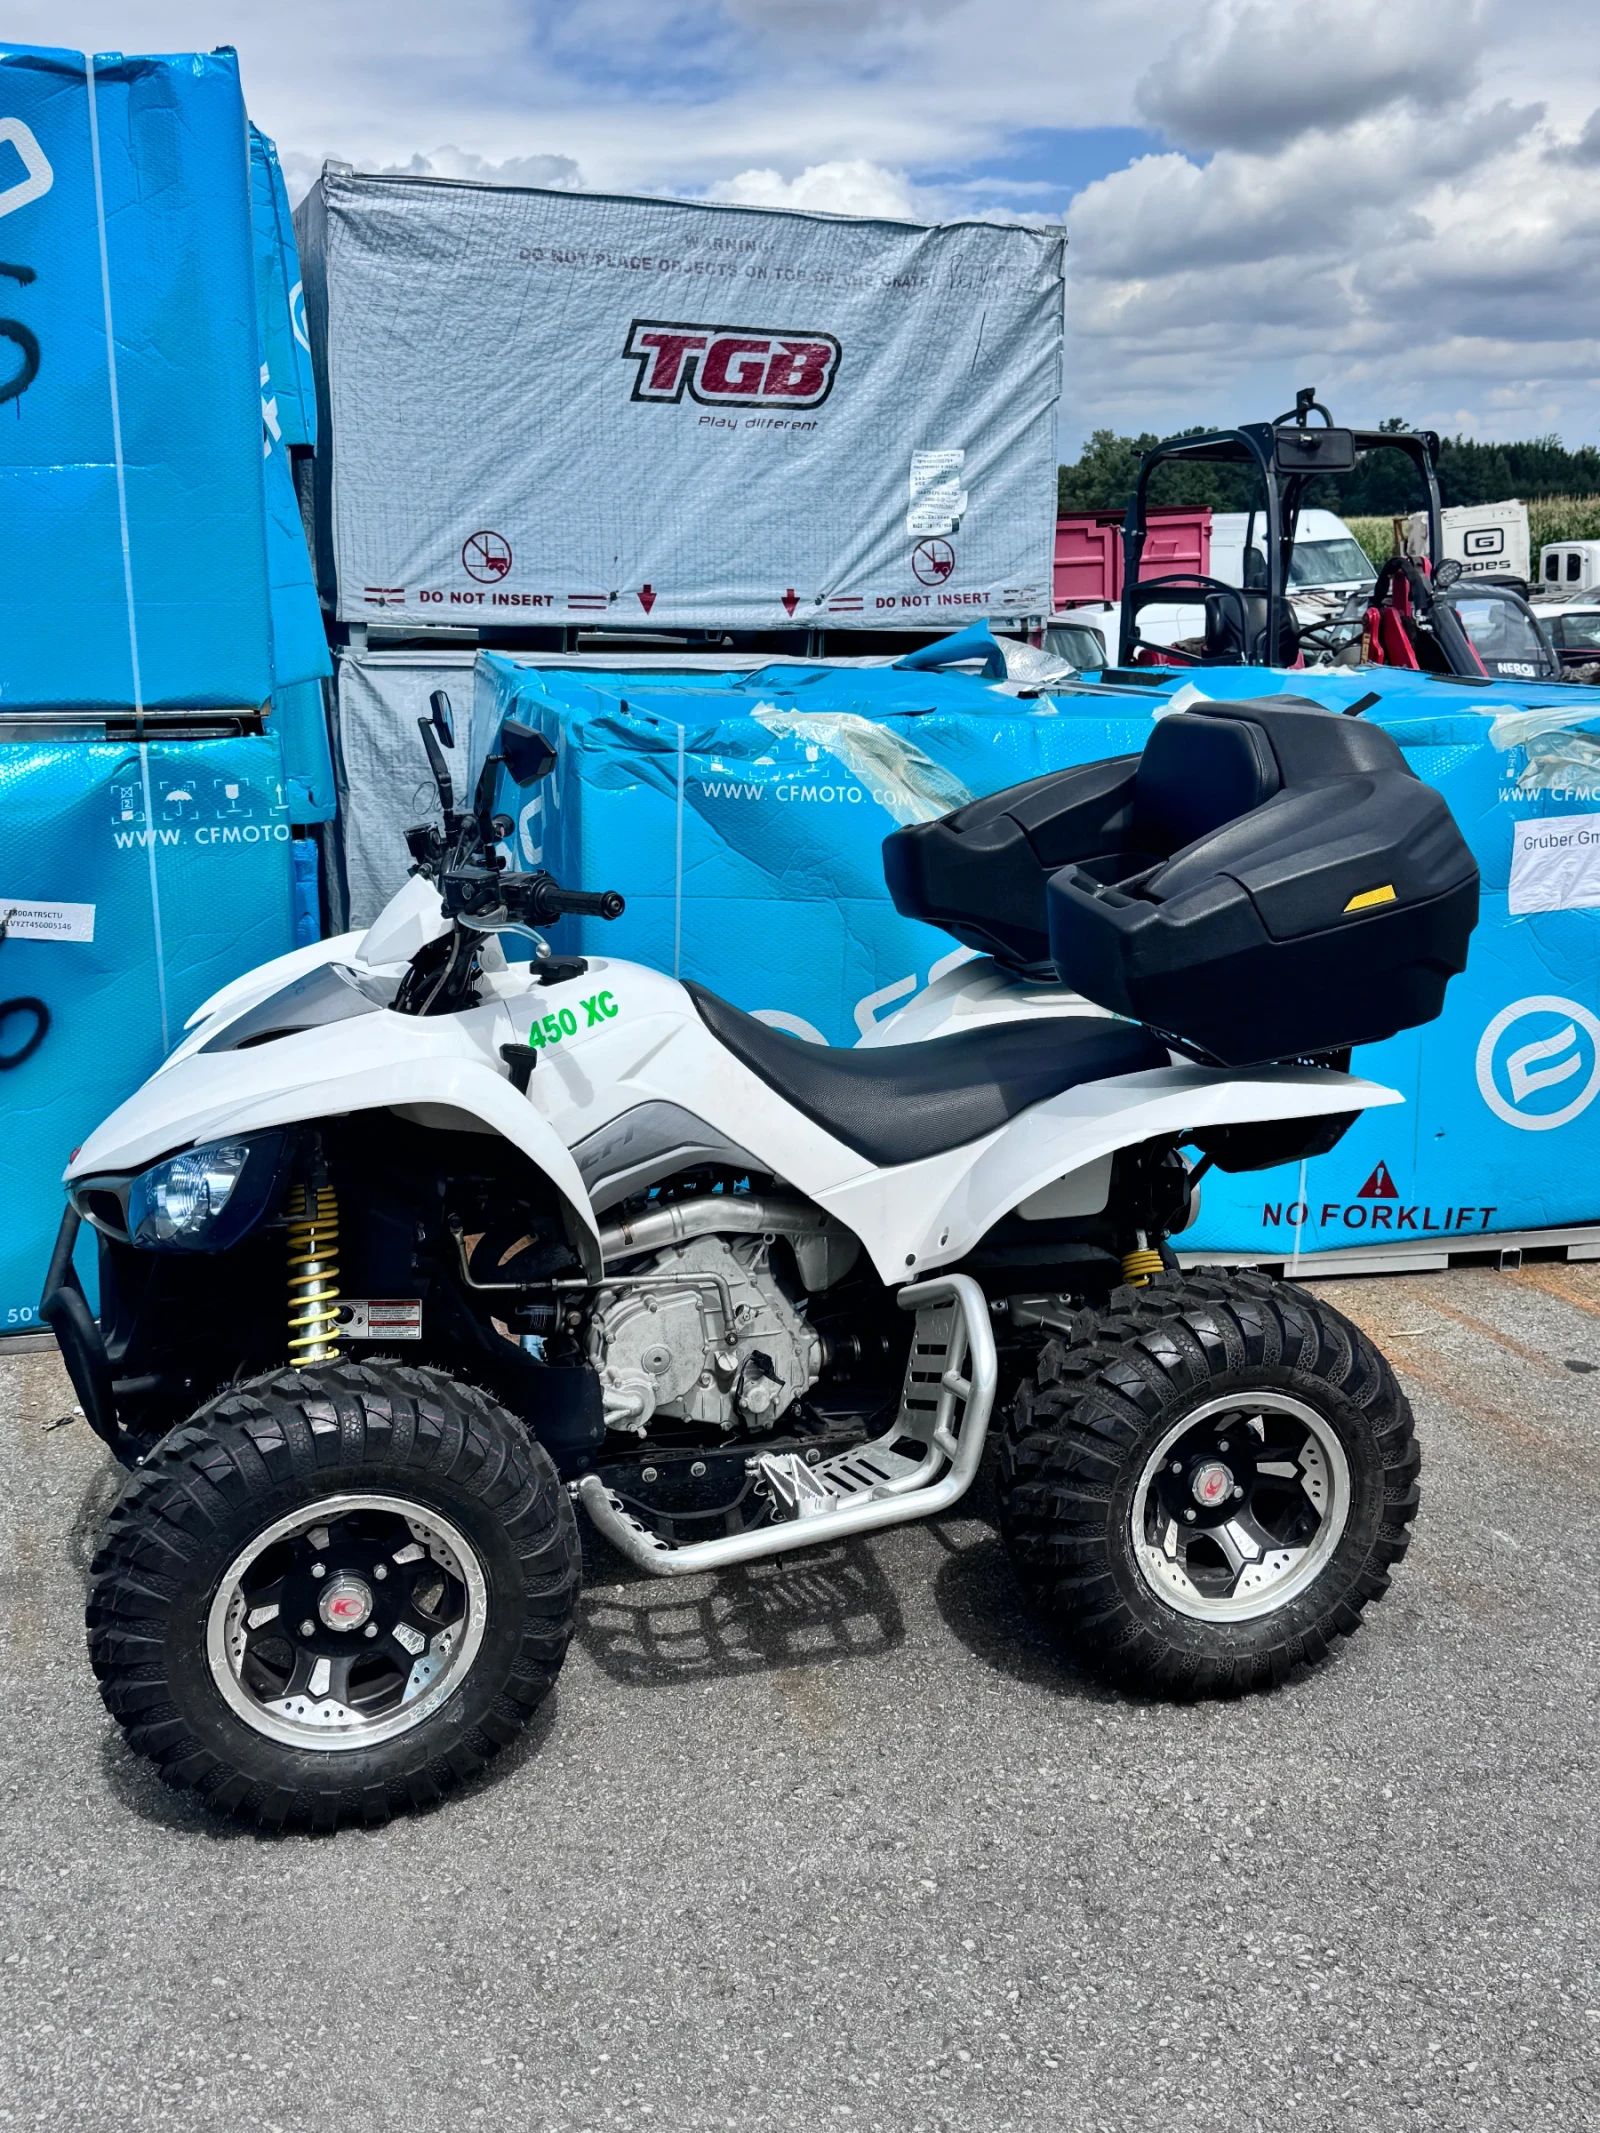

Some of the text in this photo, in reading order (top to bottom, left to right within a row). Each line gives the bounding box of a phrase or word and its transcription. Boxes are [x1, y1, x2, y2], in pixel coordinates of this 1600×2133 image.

[519, 247, 545, 262] DO
[551, 249, 588, 265] NOT
[595, 252, 652, 271] PLACE
[658, 258, 738, 278] OBJECTS
[745, 264, 768, 280] ON
[636, 328, 836, 402] TGB
[698, 415, 819, 432] Play different
[419, 590, 555, 607] DO NOT INSERT
[875, 592, 991, 609] DO NOT INSERT
[701, 781, 768, 801] WWW.
[1523, 833, 1574, 851] Gruber
[529, 990, 619, 1049] 450 XC
[1262, 1201, 1498, 1230] NO FORKLIFT
